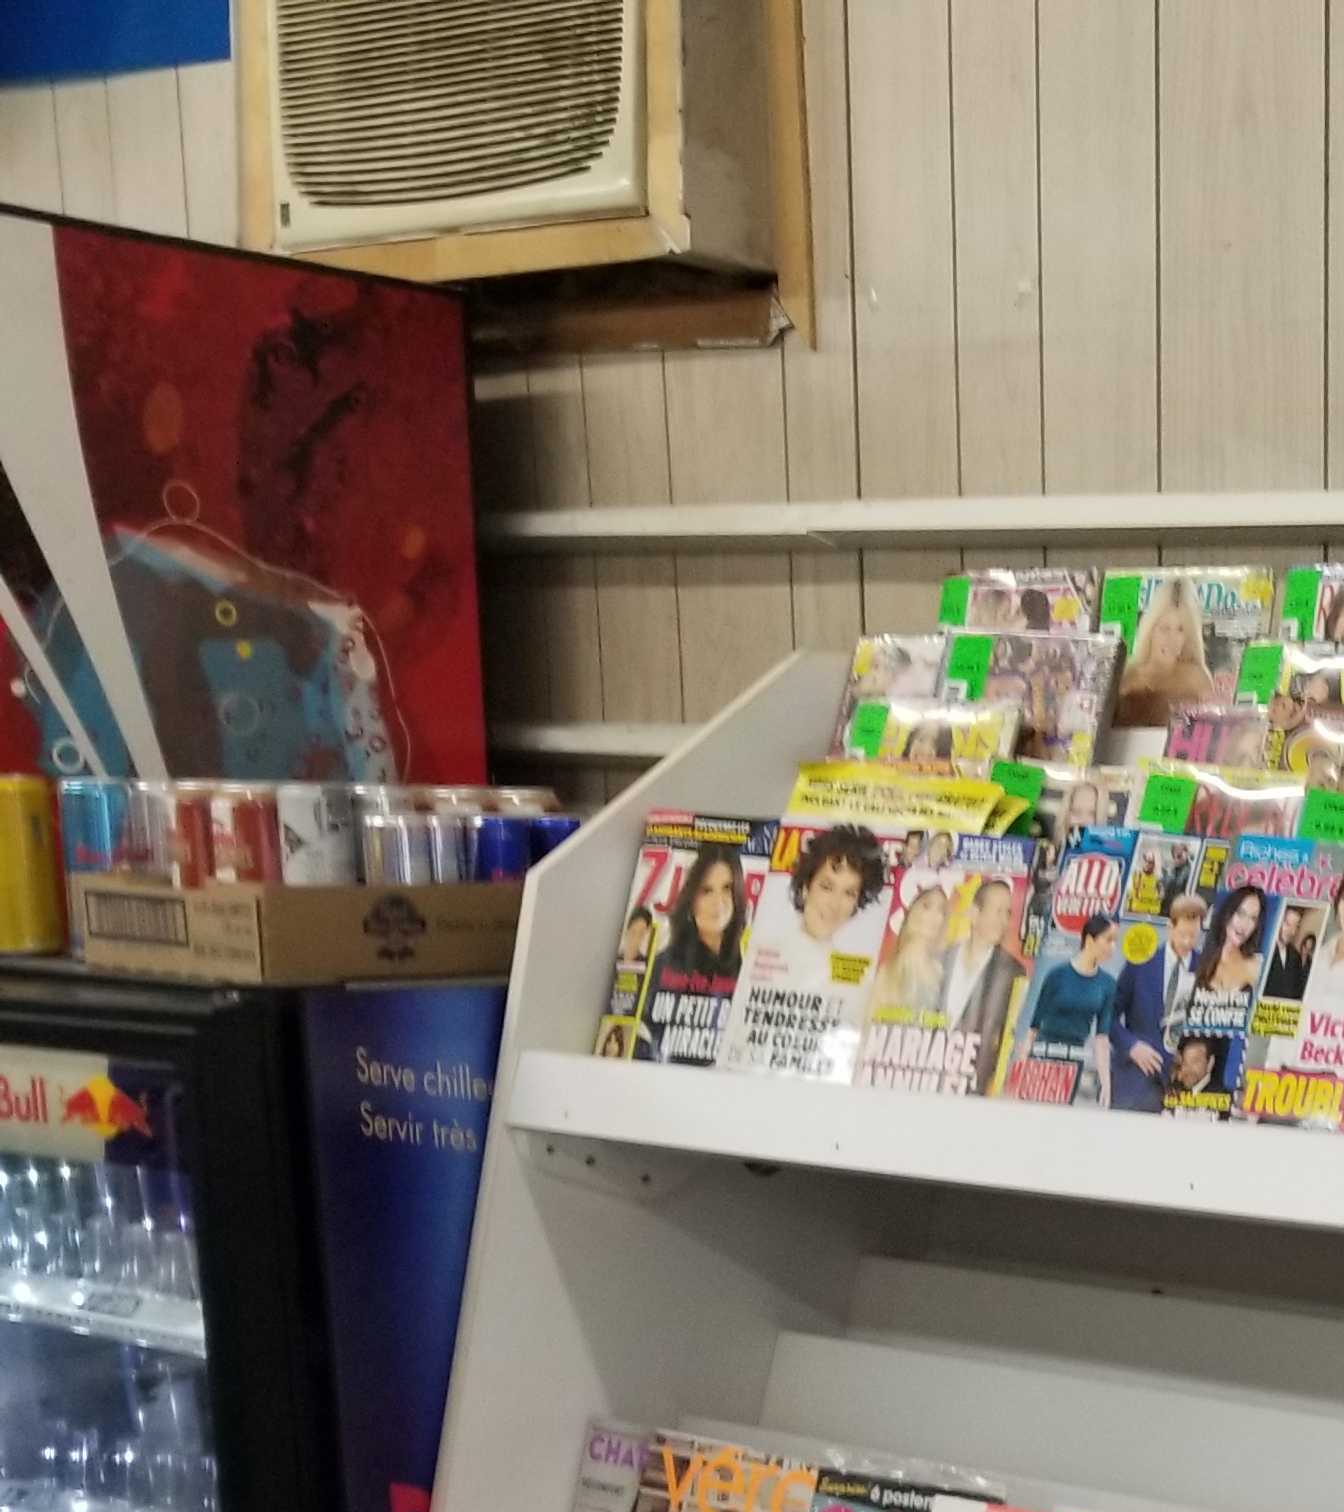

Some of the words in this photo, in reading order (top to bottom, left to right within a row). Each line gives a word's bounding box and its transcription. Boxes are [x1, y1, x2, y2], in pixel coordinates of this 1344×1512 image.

[749, 987, 823, 1012] HUMOUR
[356, 1046, 415, 1093] Serve
[424, 1060, 495, 1101] chille
[360, 1100, 424, 1146] Servir
[432, 1118, 477, 1151] très
